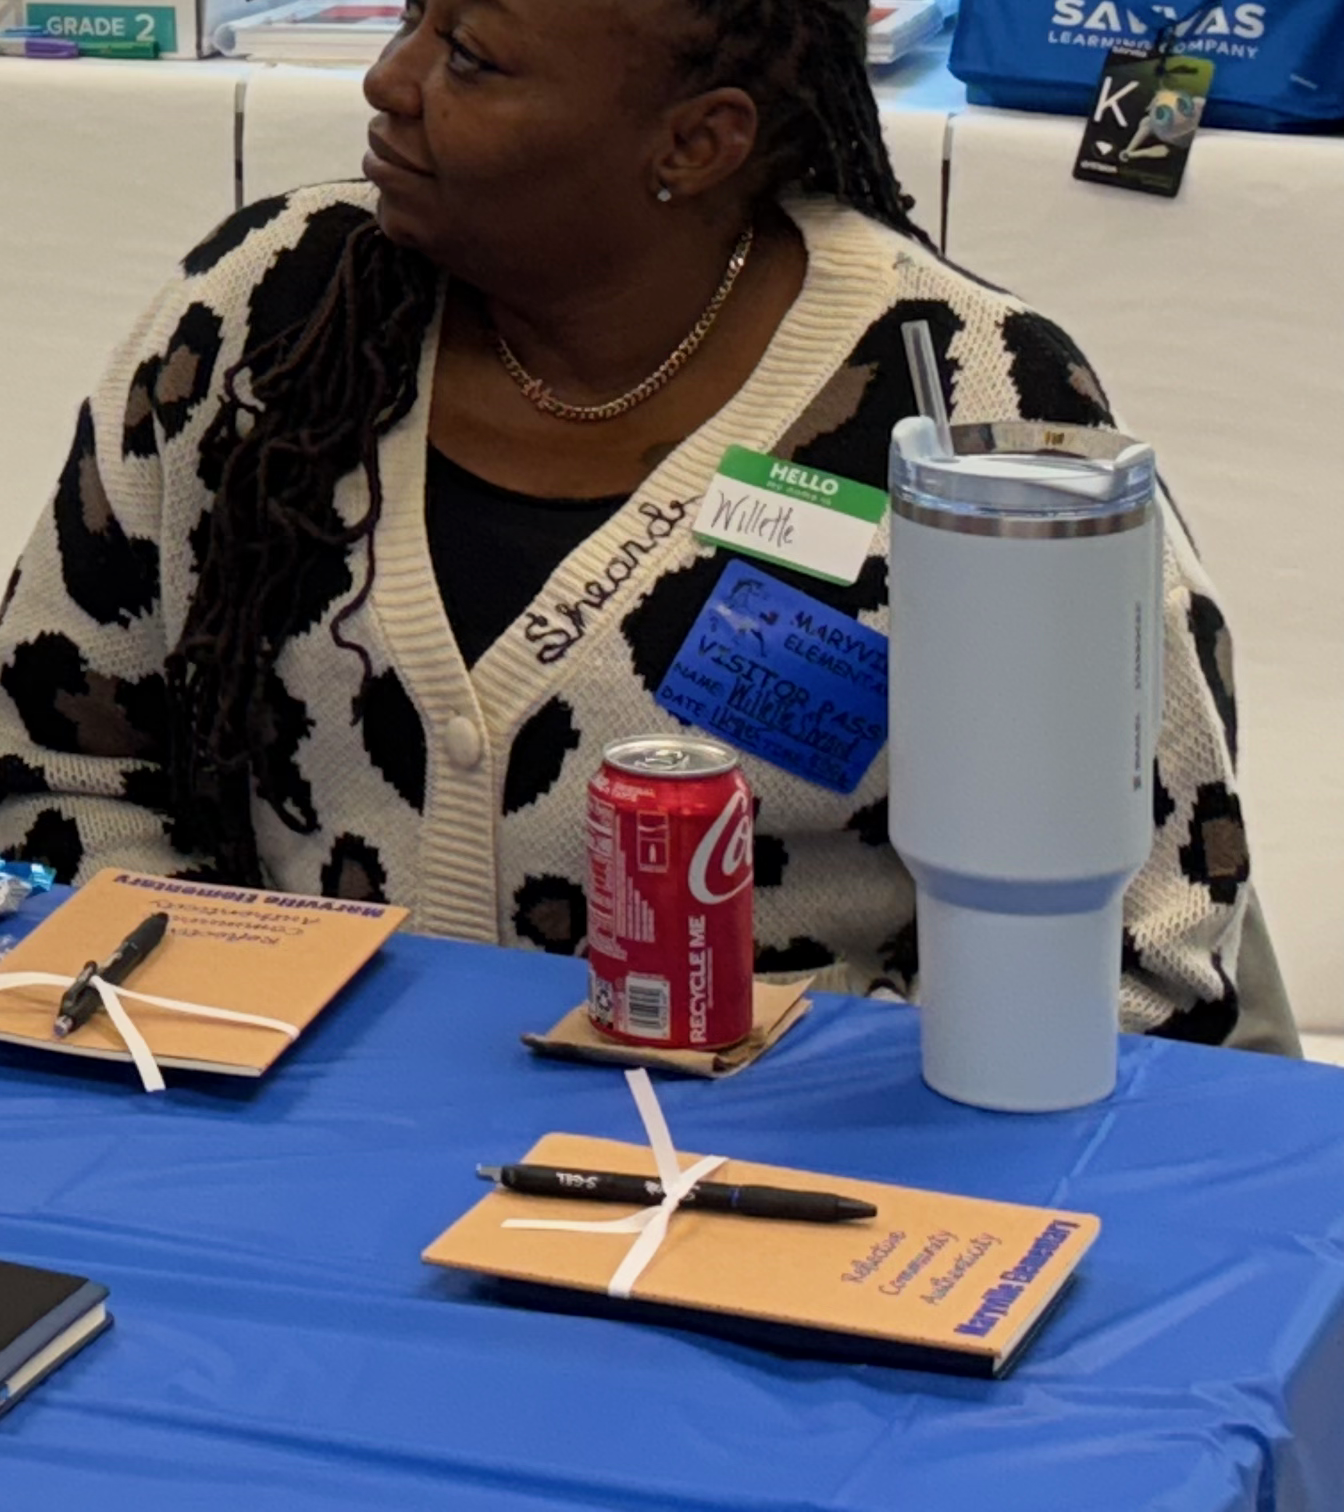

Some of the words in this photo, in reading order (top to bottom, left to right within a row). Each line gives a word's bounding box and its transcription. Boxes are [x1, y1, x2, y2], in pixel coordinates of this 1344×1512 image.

[46, 15, 125, 37] GRADE
[134, 13, 156, 42] 2
[1093, 76, 1140, 128] K
[770, 462, 839, 496] HELLO
[784, 634, 889, 698] ELEMENTA
[796, 611, 889, 675] MARYVI
[699, 636, 811, 708] VISITOR
[816, 700, 883, 741] PASS
[112, 873, 260, 904] Elementary
[262, 893, 386, 919] Maryville
[688, 914, 707, 948] ME
[688, 948, 708, 1043] RECYCLE
[840, 1230, 907, 1284] Reflective
[878, 1229, 960, 1297] Community
[919, 1231, 1003, 1307] Authenticity
[953, 1282, 1025, 1338] Maryville
[999, 1219, 1081, 1285] Elementary
